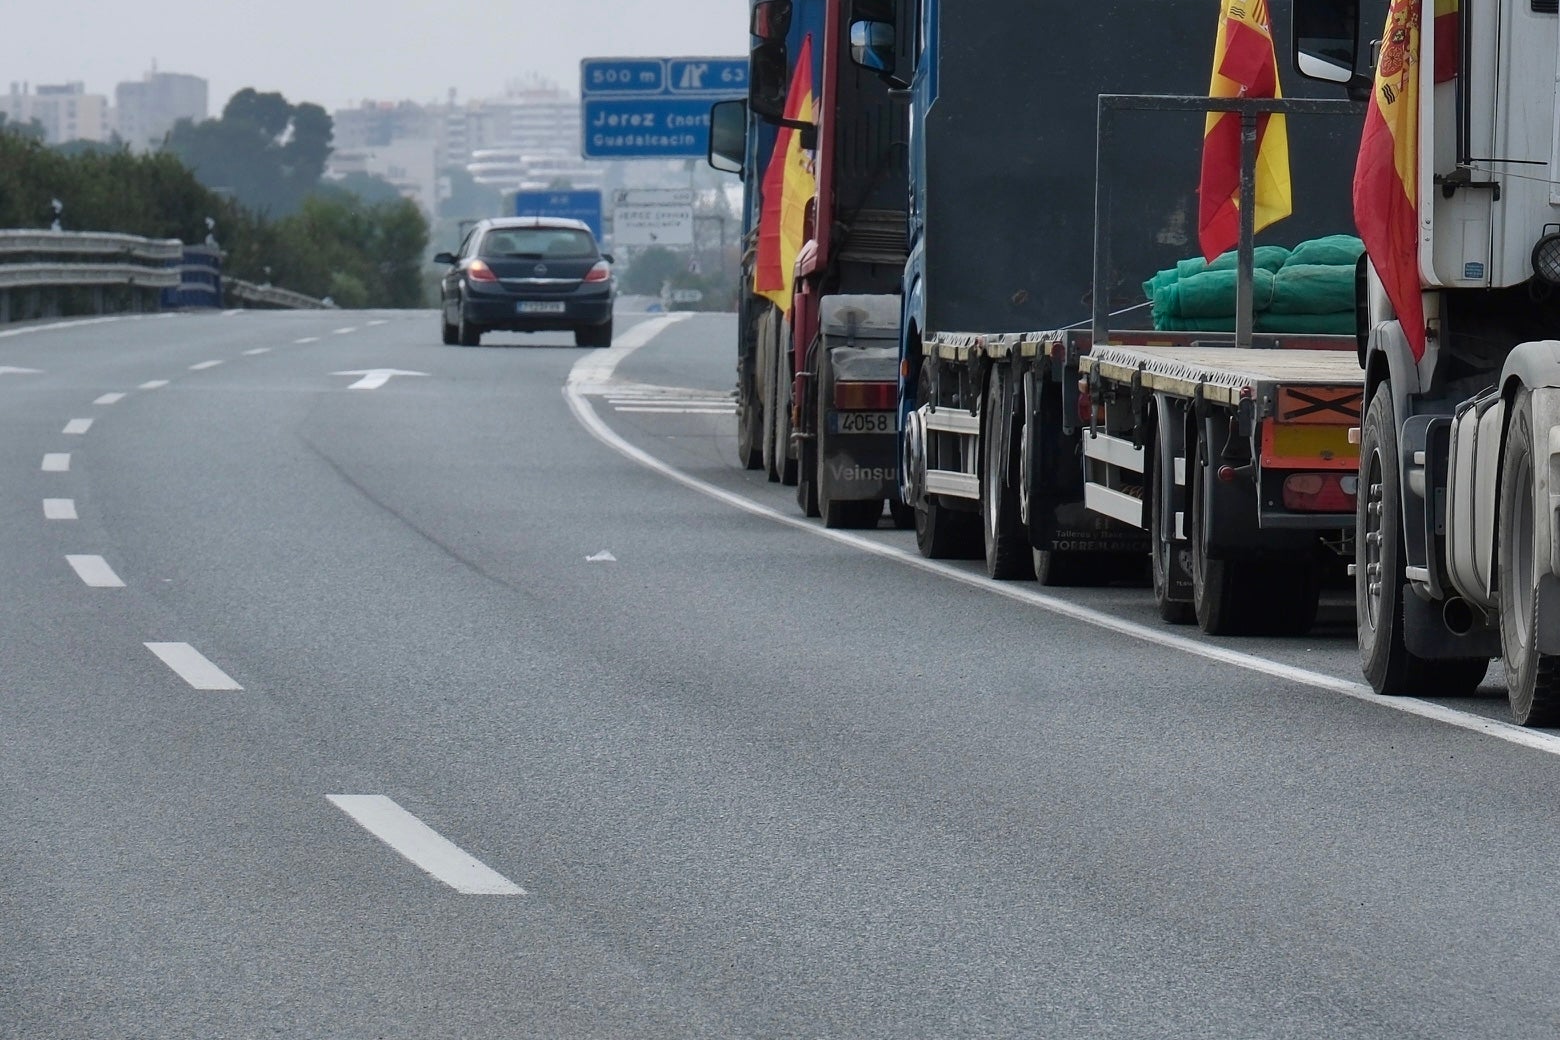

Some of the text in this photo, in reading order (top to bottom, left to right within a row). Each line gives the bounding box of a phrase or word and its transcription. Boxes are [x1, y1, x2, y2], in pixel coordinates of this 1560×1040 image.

[592, 69, 656, 84] 500 m
[721, 68, 745, 82] 63
[593, 111, 710, 127] Jerez (nort
[842, 415, 887, 431] 4058
[832, 464, 899, 481] Veinsu
